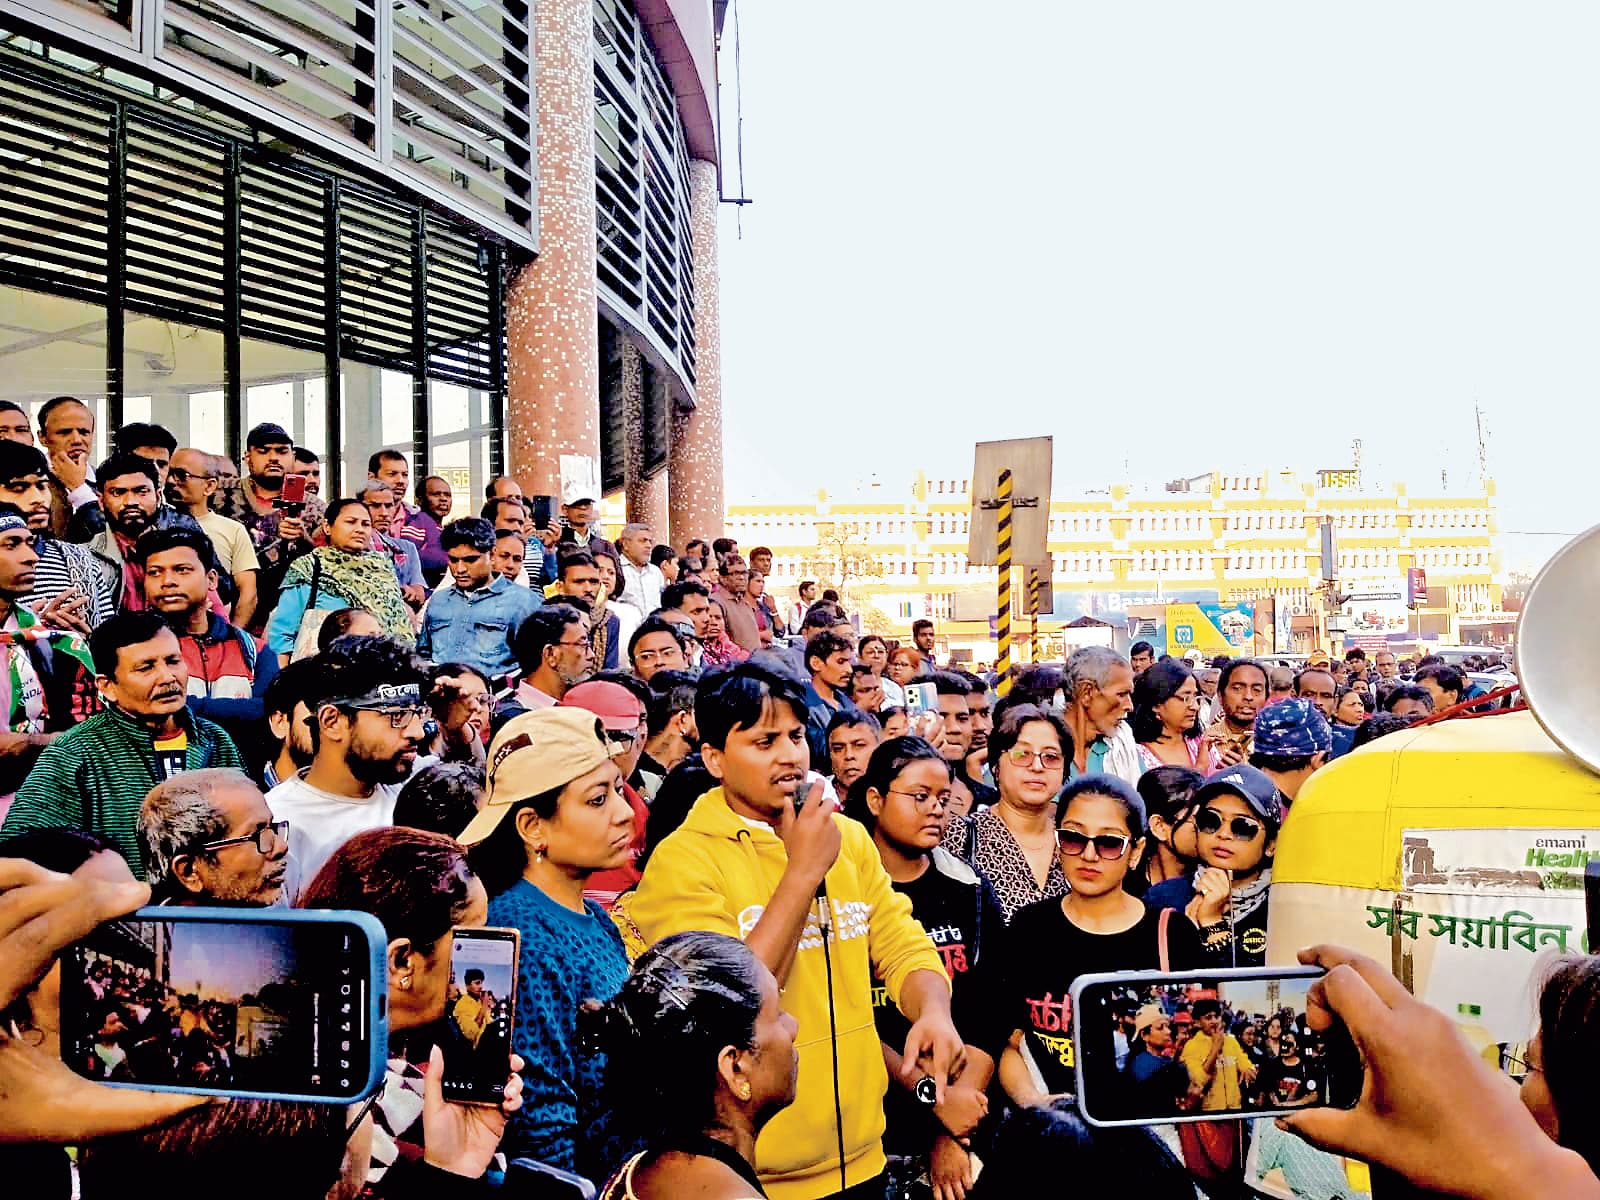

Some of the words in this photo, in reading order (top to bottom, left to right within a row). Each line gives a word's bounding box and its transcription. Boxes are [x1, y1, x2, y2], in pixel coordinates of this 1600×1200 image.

[1535, 835, 1587, 848] emami
[1366, 905, 1423, 940] সব
[1428, 910, 1573, 954] সয়াবিন
